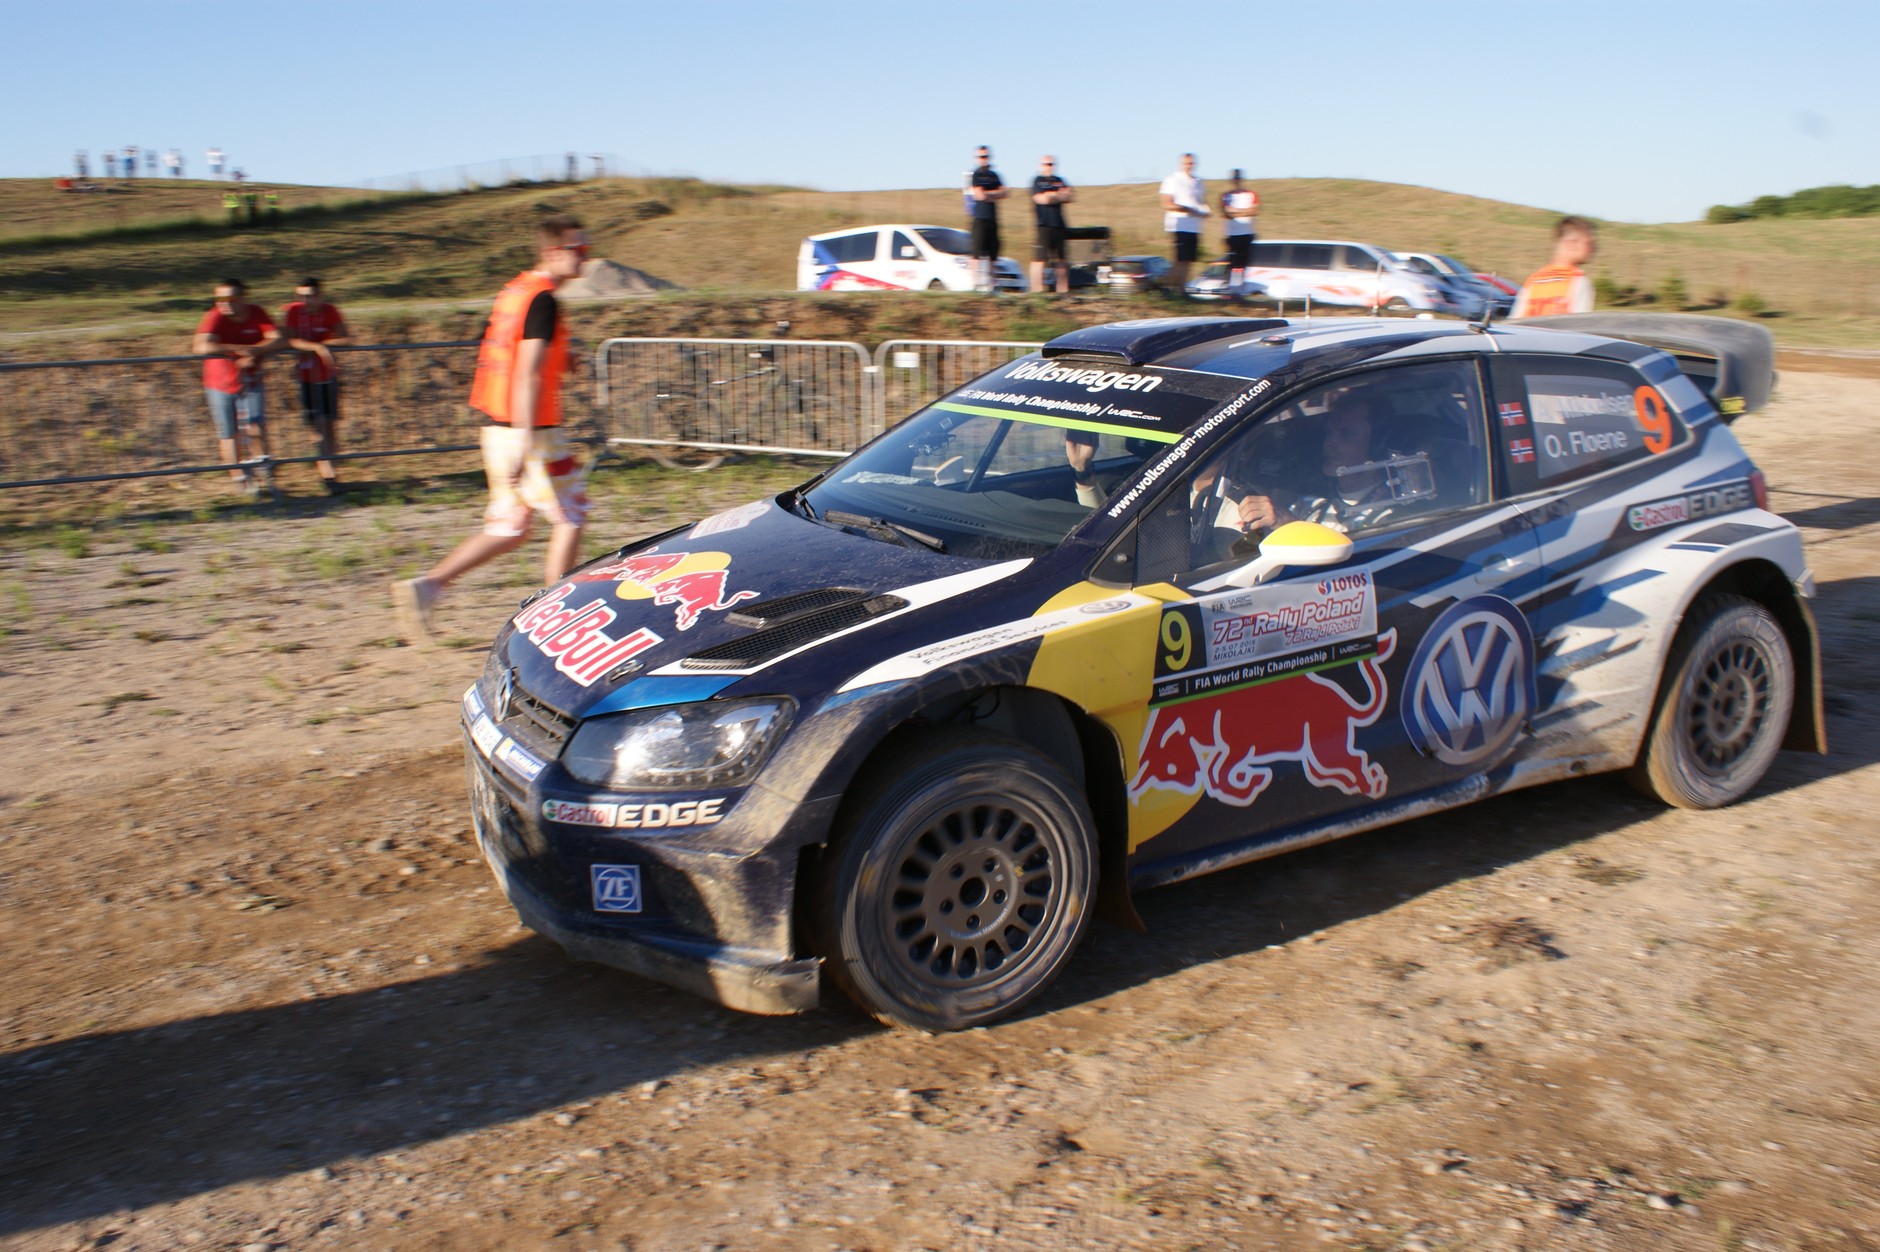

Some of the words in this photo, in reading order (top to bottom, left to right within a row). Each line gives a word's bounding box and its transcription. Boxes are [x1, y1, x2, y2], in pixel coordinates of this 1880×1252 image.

[1004, 361, 1163, 393] Volkswagen
[1002, 394, 1029, 406] Rally
[1025, 396, 1101, 416] Championship
[1633, 385, 1673, 455] 9
[1107, 377, 1272, 519] www.volkswagen-motorsport.com
[1543, 434, 1567, 458] O.
[1641, 503, 1688, 527] Castrol
[1688, 484, 1751, 519] EDGE
[1331, 573, 1368, 593] LOTOS
[514, 583, 606, 645] Red
[1252, 607, 1302, 638] Rally
[1301, 591, 1365, 627] Poland
[1285, 631, 1303, 646] 72
[1303, 623, 1328, 642] Rajd
[1327, 616, 1361, 636] Polski
[539, 606, 662, 686] Bull
[907, 628, 1013, 659] Volkswagen
[922, 638, 1000, 665] Financial
[1001, 620, 1068, 640] Services
[1160, 610, 1192, 671] 9
[1195, 679, 1212, 690] FIA
[1212, 672, 1240, 687] World
[1242, 665, 1265, 679] Rally
[1267, 651, 1328, 674] Championship
[556, 803, 613, 825] Castrol
[615, 797, 727, 828] EDGE
